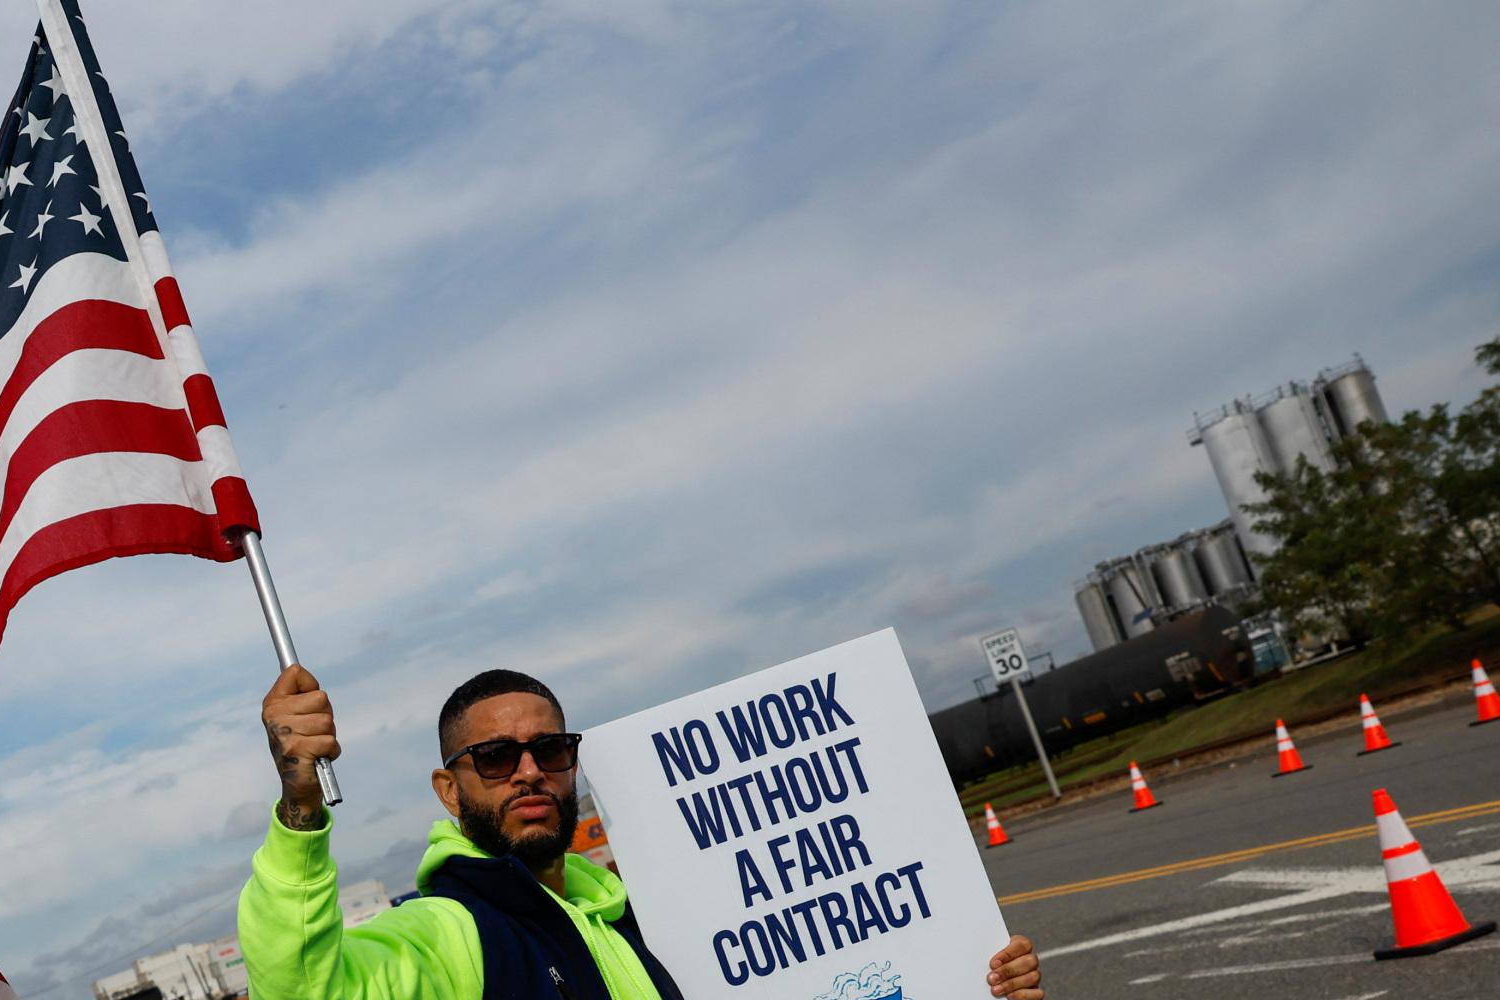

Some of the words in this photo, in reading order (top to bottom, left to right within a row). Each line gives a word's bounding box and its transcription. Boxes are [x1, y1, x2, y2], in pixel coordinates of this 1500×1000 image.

[996, 654, 1022, 675] 30
[651, 719, 720, 787] NO
[715, 672, 855, 763] WORK
[676, 737, 869, 850] WITHOUT
[735, 849, 773, 908] A
[767, 814, 872, 894] FAIR
[712, 861, 932, 986] CONTRACT
